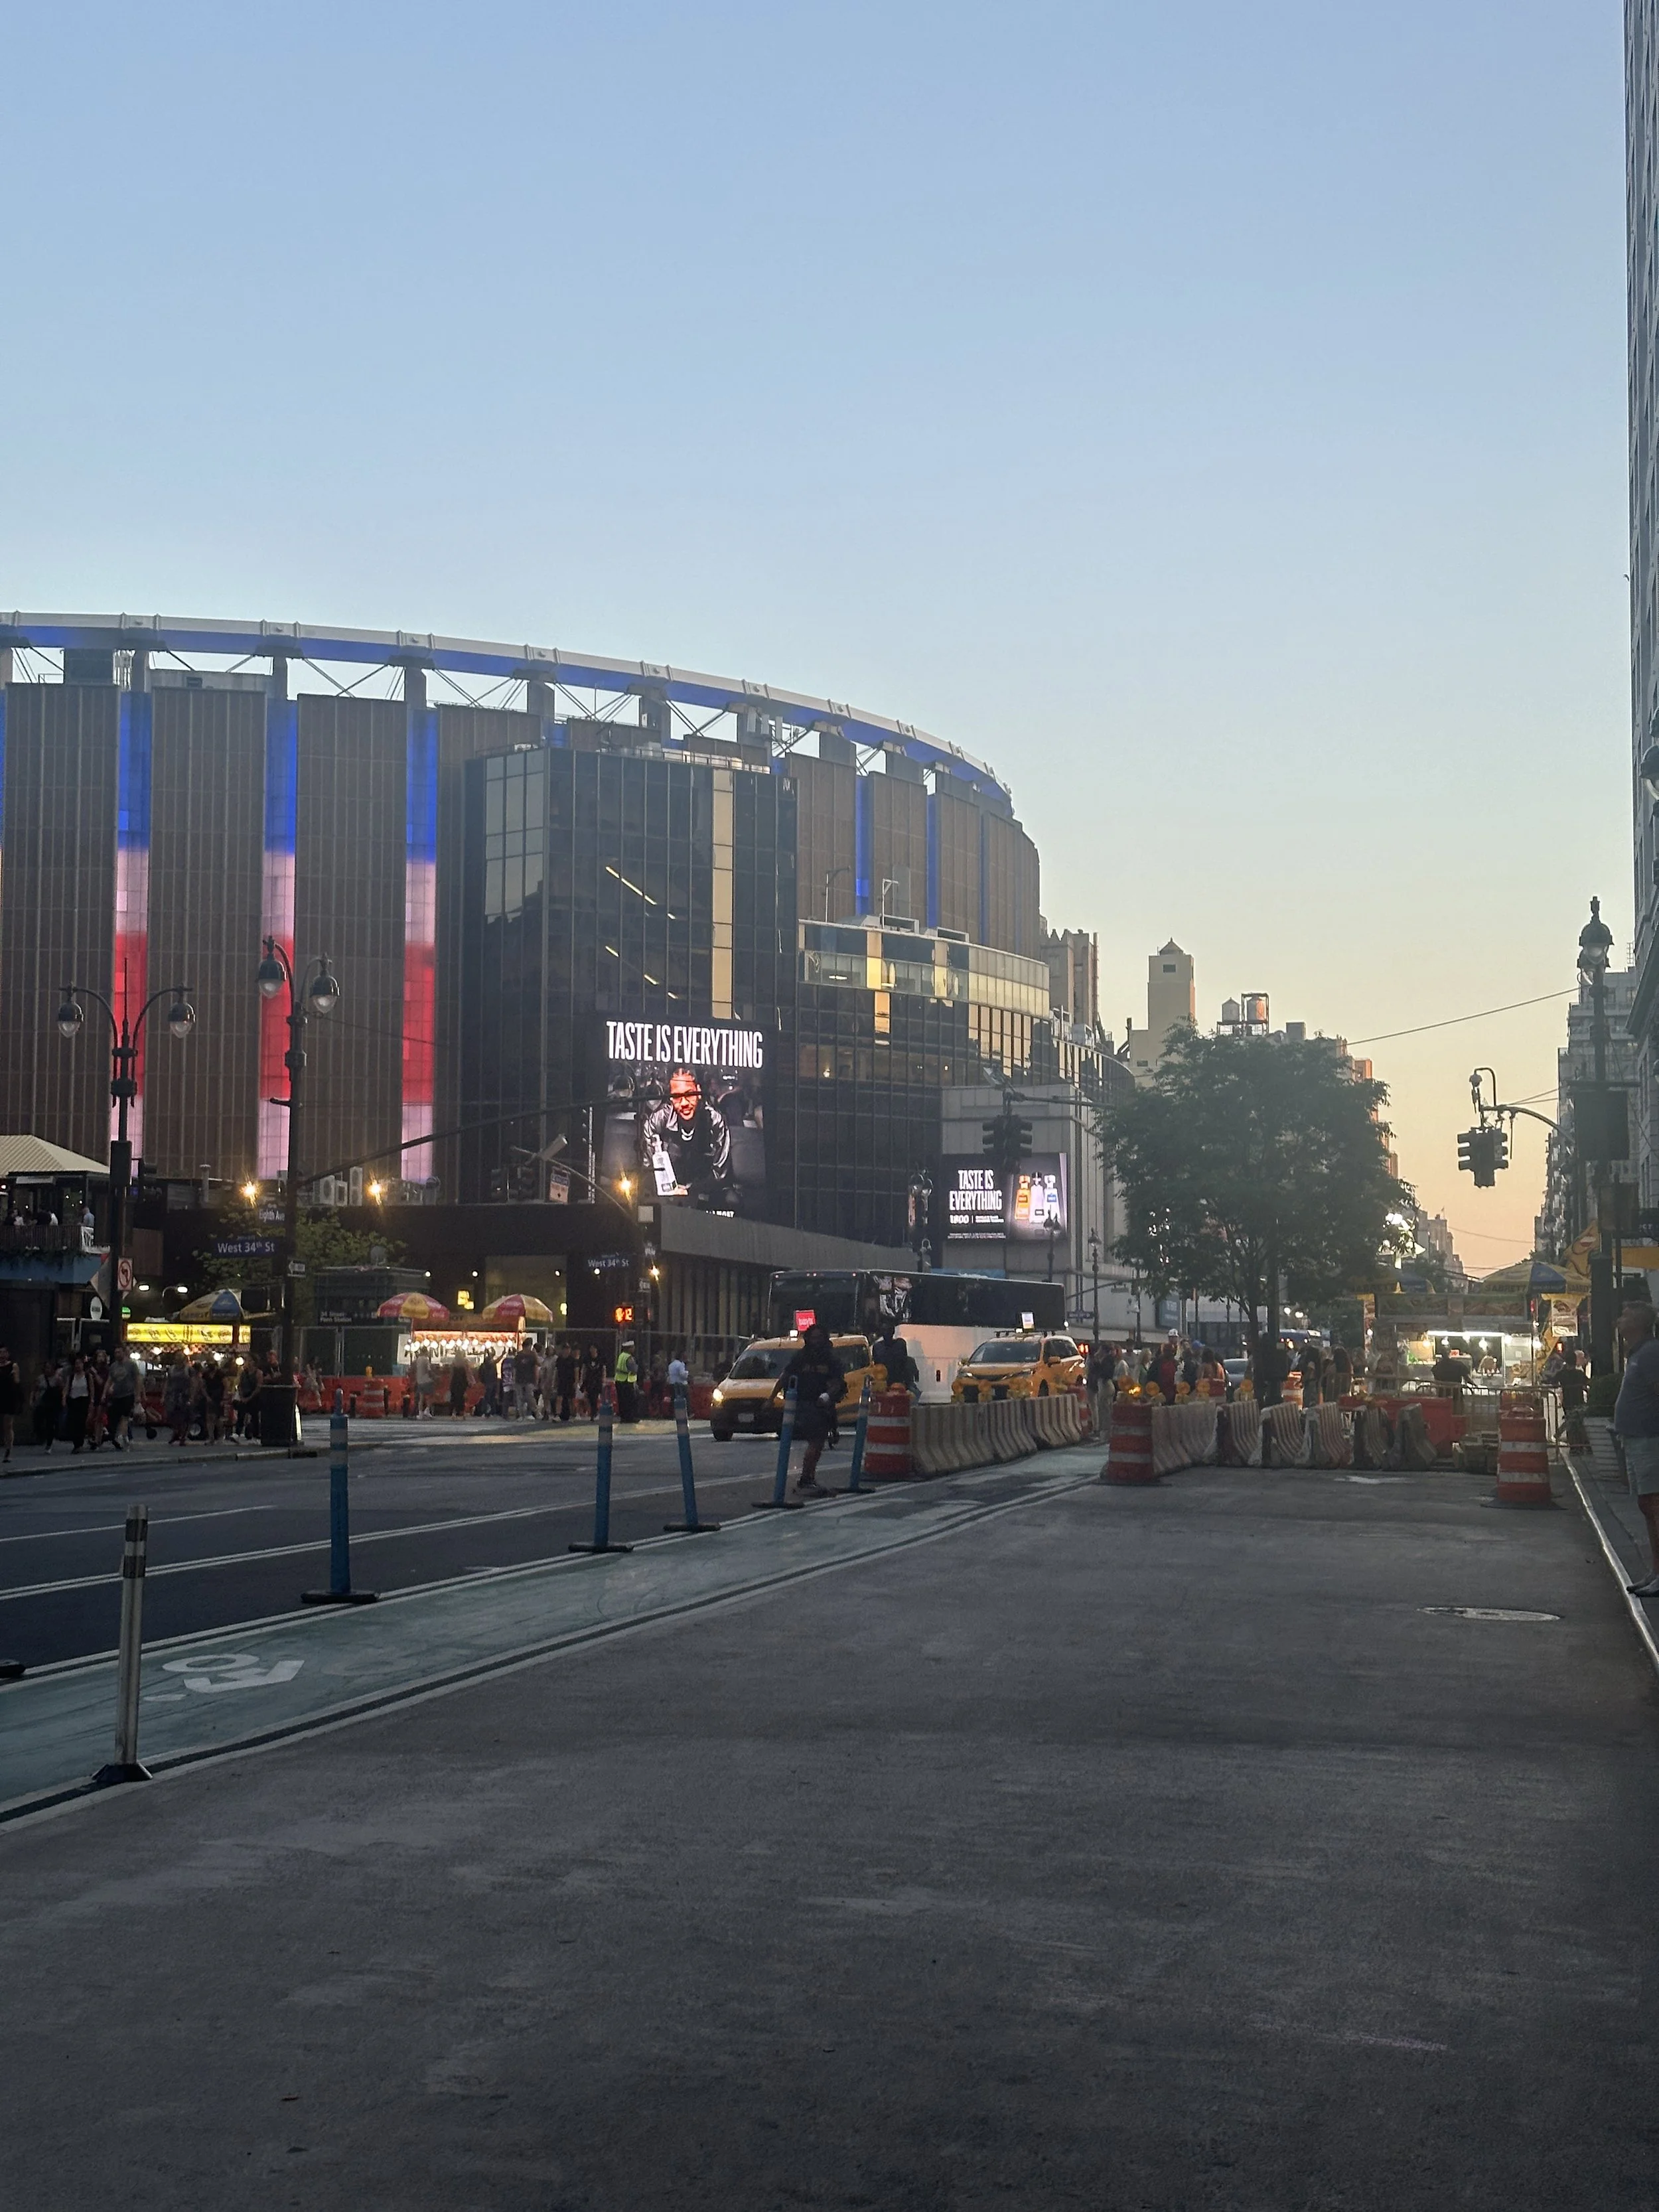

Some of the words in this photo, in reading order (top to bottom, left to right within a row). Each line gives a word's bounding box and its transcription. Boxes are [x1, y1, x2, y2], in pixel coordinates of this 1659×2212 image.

[606, 1021, 654, 1061] TASTE
[656, 1024, 671, 1063] IS
[673, 1025, 763, 1069] EVERYTHING
[958, 1169, 984, 1190] TASTE
[985, 1169, 994, 1189] IS
[949, 1190, 1003, 1211] EVERYTHING
[275, 1210, 285, 1221] Ave
[217, 1242, 242, 1253] West
[244, 1241, 263, 1252] 34th
[265, 1241, 275, 1252] St
[622, 1258, 629, 1267] St
